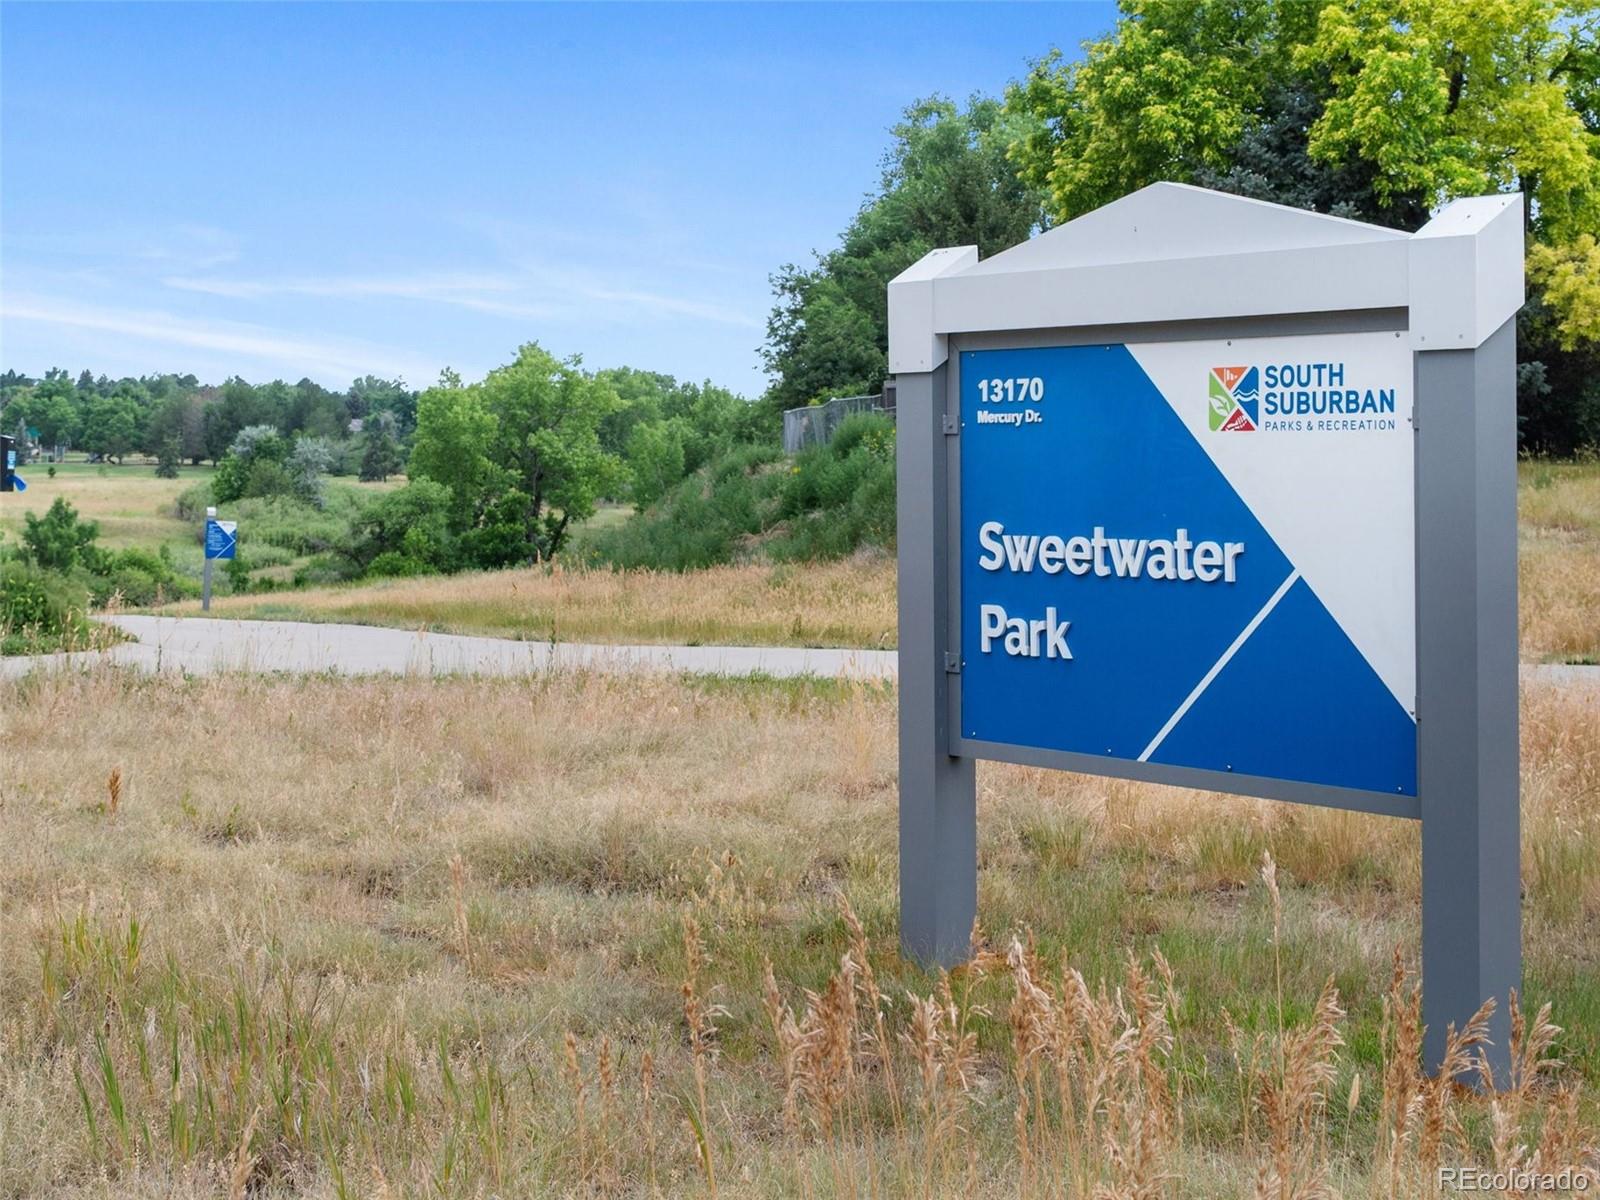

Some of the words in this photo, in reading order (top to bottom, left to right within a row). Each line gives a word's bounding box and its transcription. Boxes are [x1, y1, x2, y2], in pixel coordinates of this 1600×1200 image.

[1264, 363, 1344, 388] SOUTH
[977, 377, 1044, 402] 13170
[1264, 389, 1395, 415] SUBURBAN
[977, 410, 1023, 426] Mercury
[1025, 409, 1042, 423] Dr.
[1265, 420, 1302, 431] PARKS
[1307, 420, 1314, 431] &
[1319, 419, 1395, 431] RECREATION
[978, 521, 1245, 583] Sweetwater
[980, 604, 1074, 660] Park
